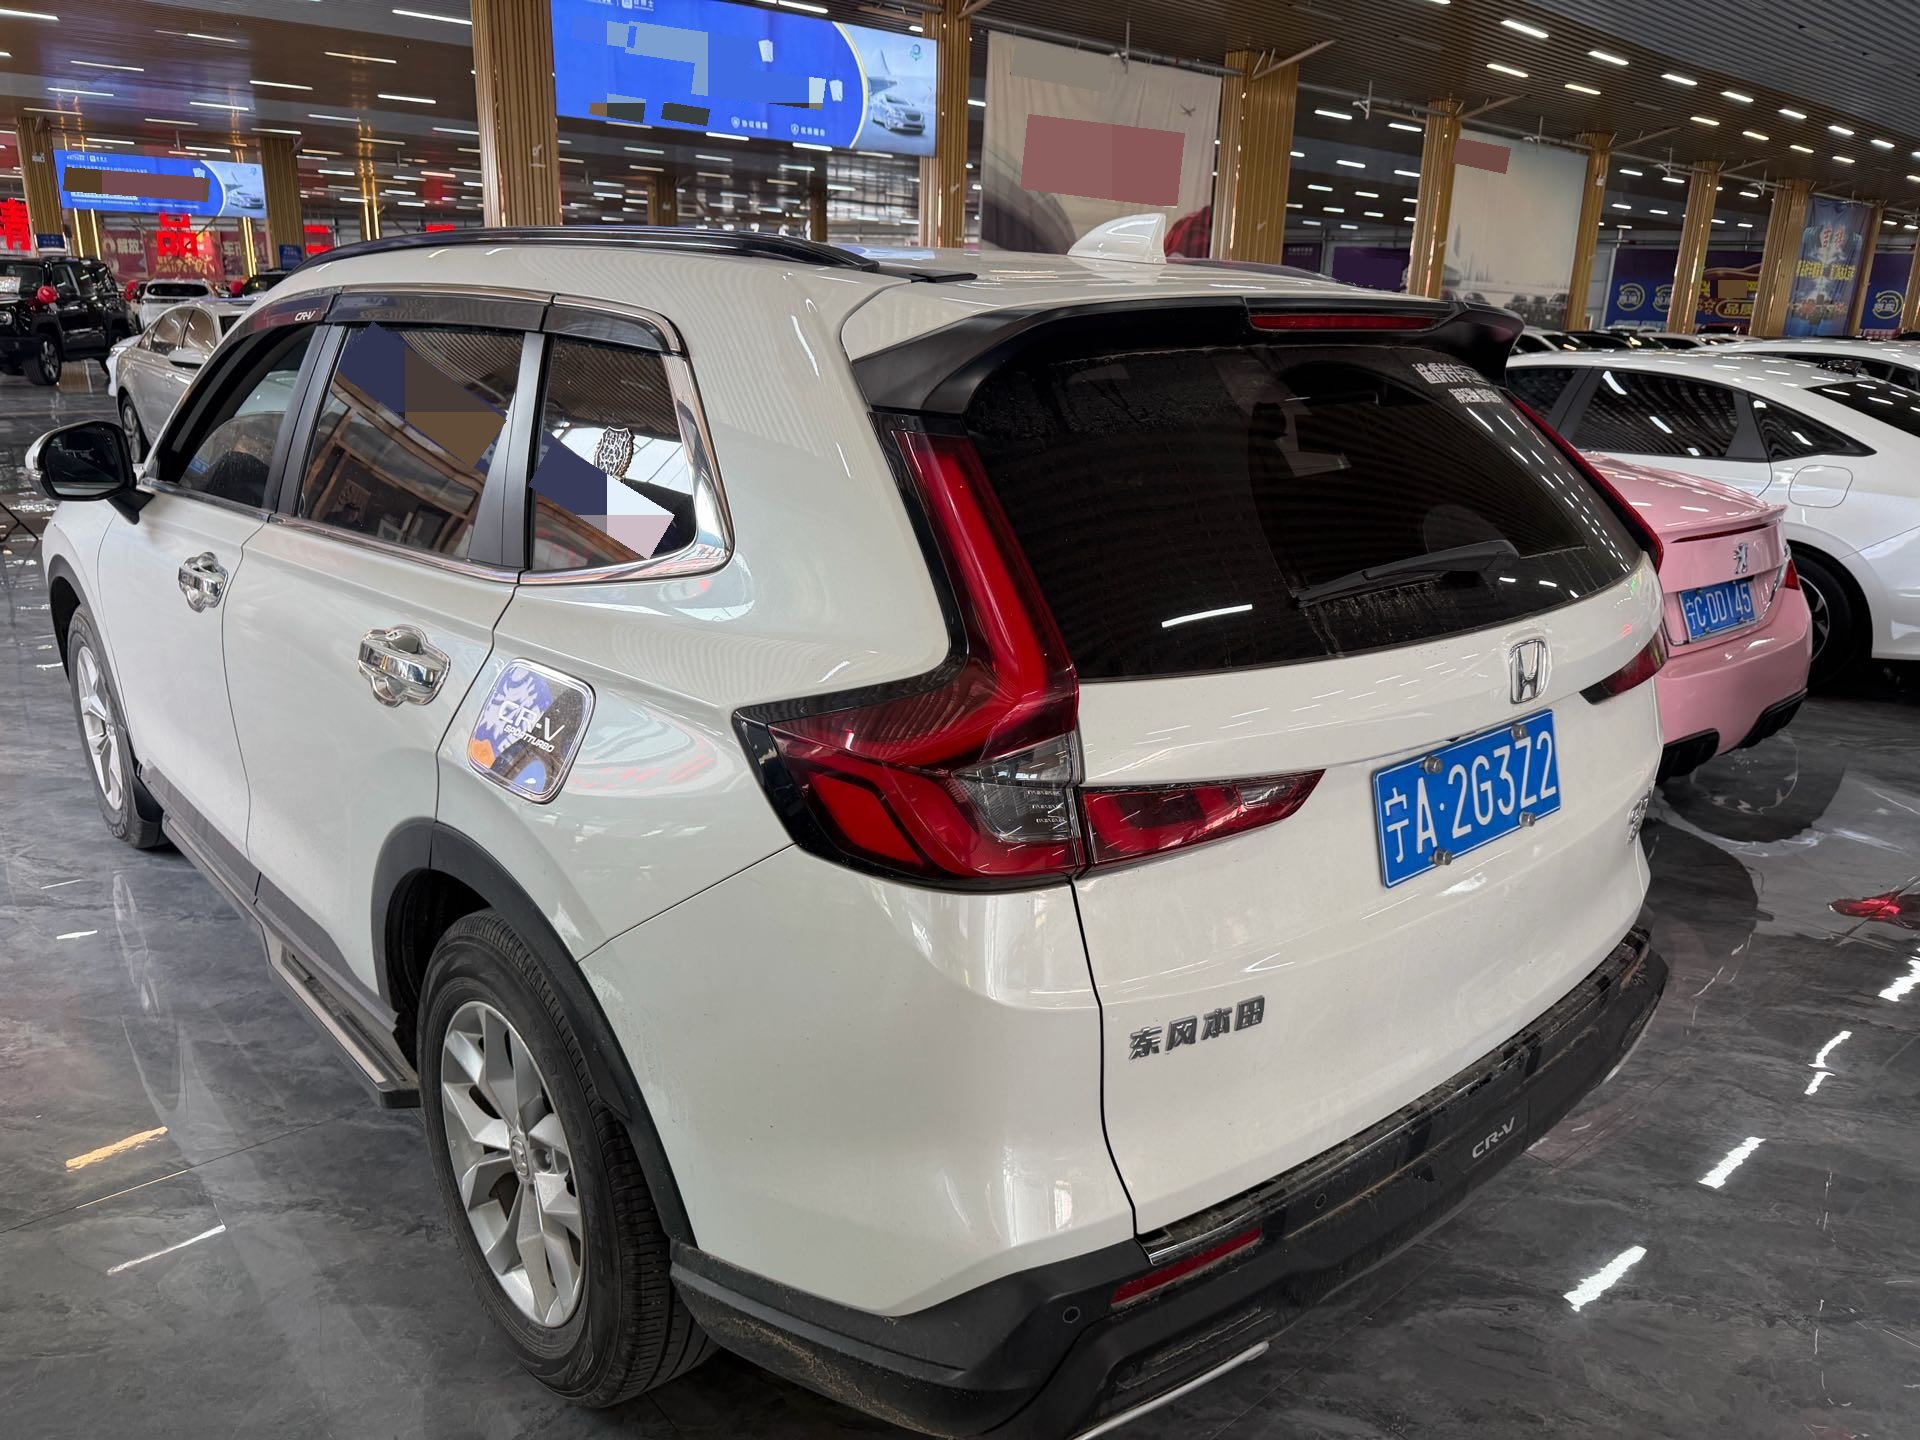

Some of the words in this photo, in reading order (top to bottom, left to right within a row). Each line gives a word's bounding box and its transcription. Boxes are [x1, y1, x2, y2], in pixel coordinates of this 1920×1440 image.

[498, 700, 566, 742] CR-V
[1129, 995, 1265, 1060] 东风本田
[1472, 1116, 1515, 1159] CR-V
